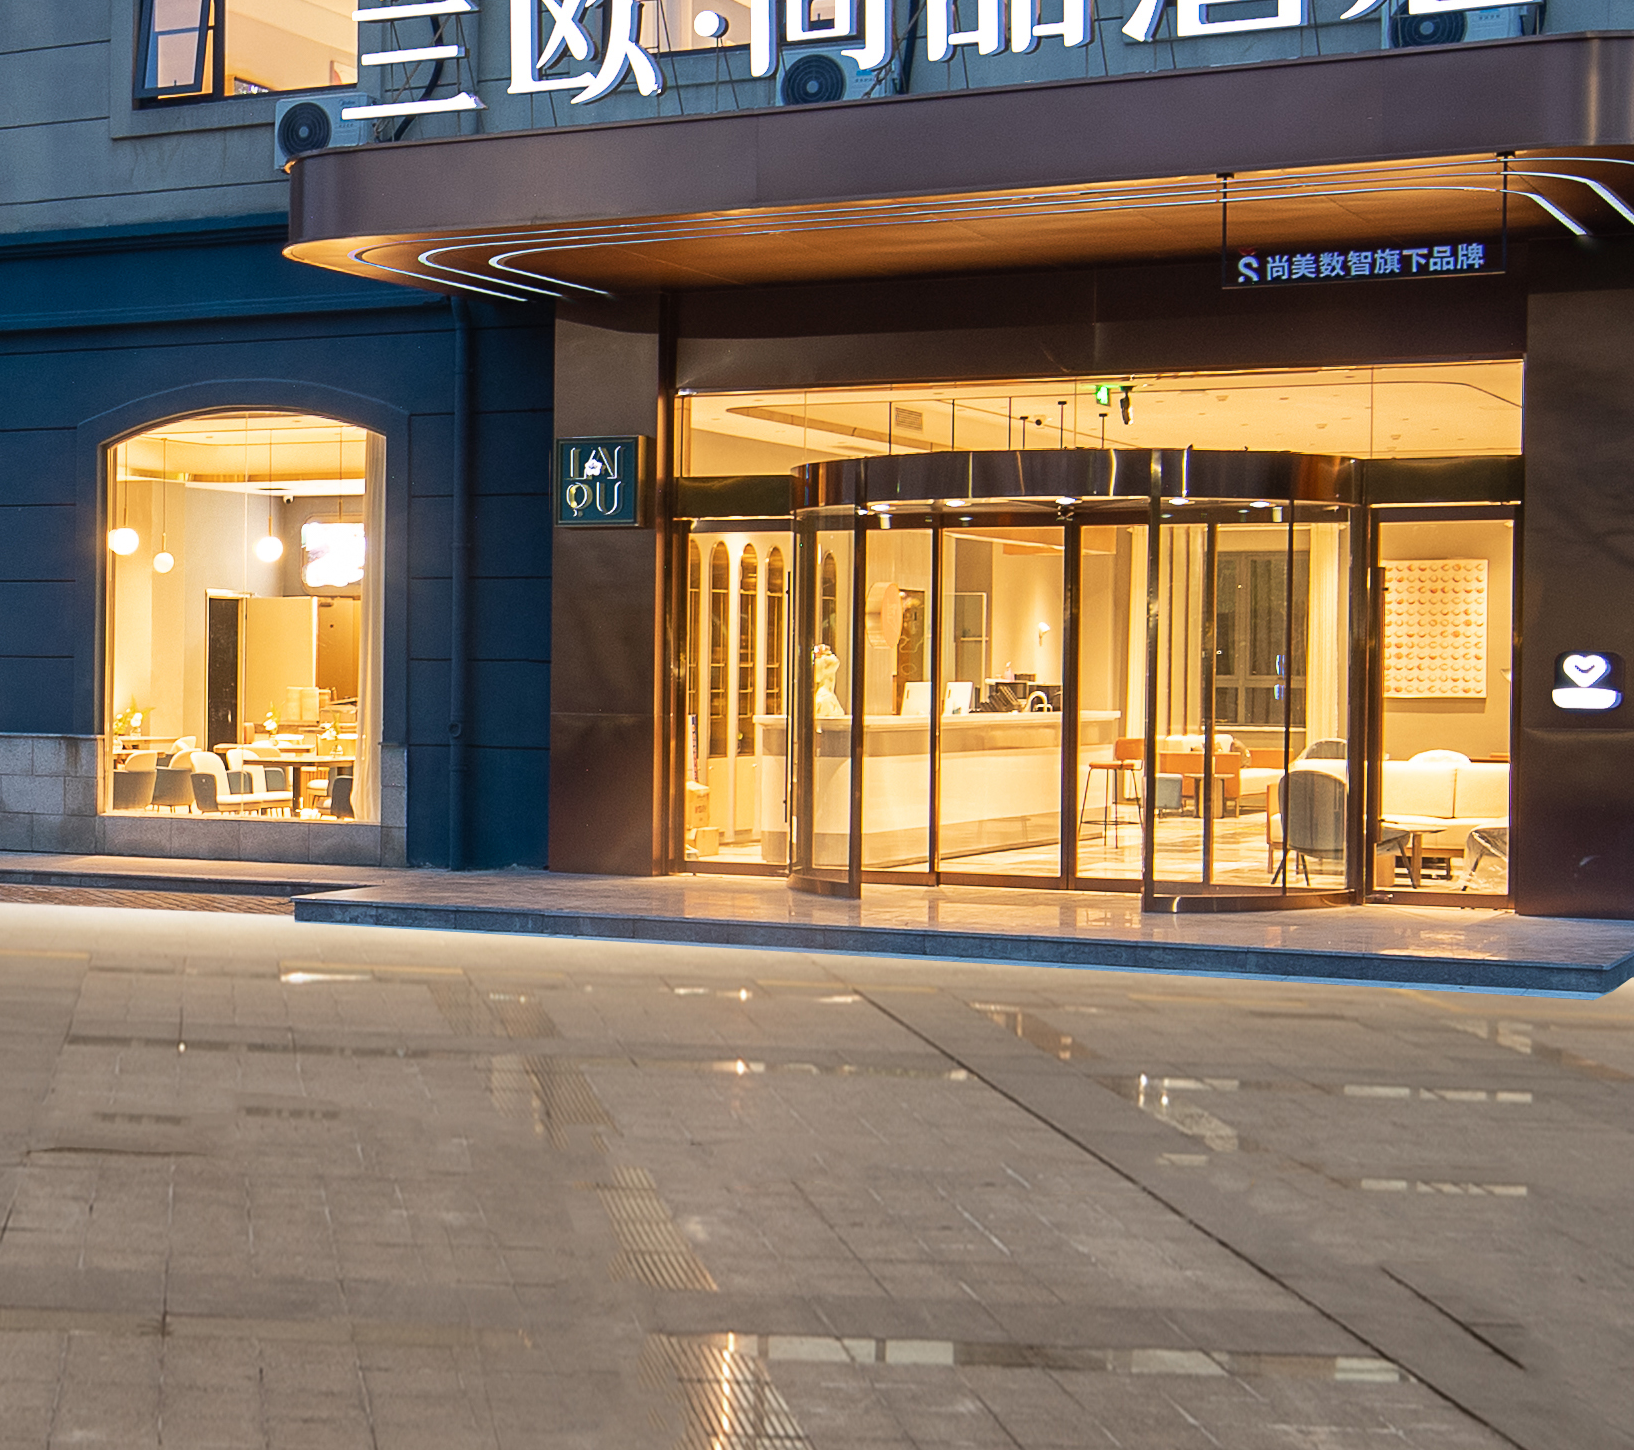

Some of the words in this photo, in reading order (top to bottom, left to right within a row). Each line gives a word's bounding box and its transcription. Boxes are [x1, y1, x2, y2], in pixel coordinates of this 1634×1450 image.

[1266, 243, 1486, 281] 尚美数智旗下品牌
